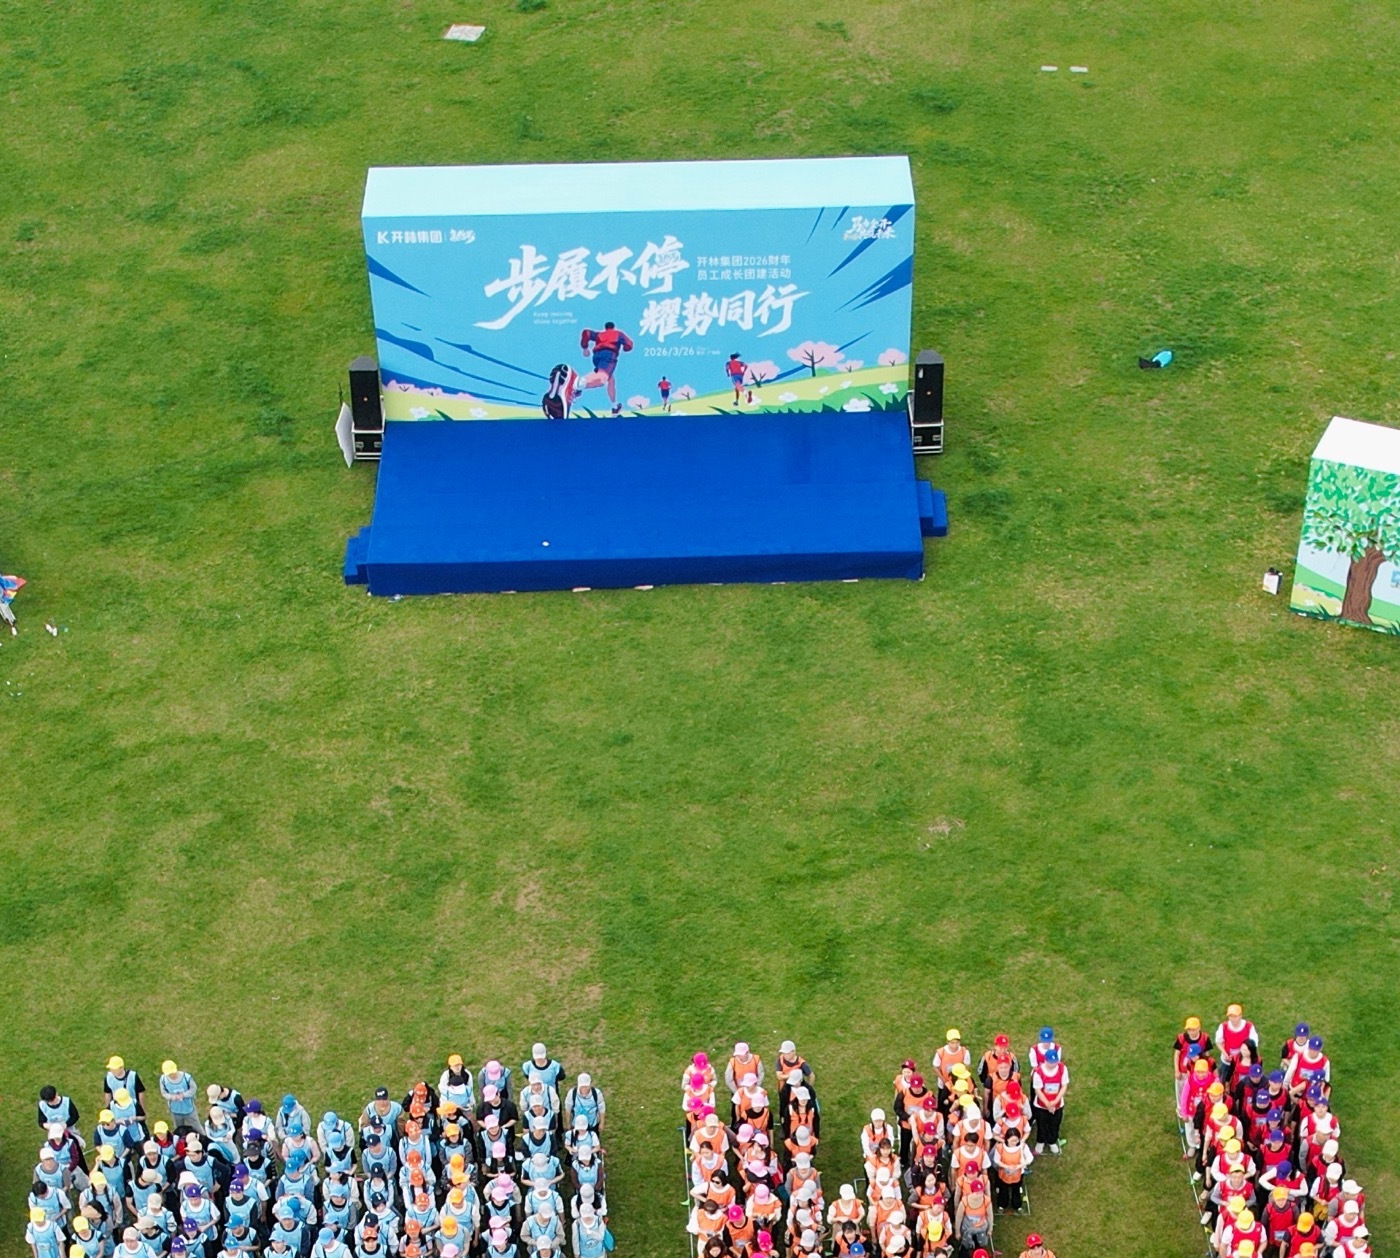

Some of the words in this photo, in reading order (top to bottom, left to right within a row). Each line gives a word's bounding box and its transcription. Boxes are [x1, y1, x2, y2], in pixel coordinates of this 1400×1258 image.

[697, 255, 791, 267] 开林集团2026财年
[697, 268, 791, 281] 员工成长团建活动
[473, 235, 690, 330] 步履不停
[639, 283, 811, 343] 耀势同行
[643, 347, 694, 357] 2026/3/26
